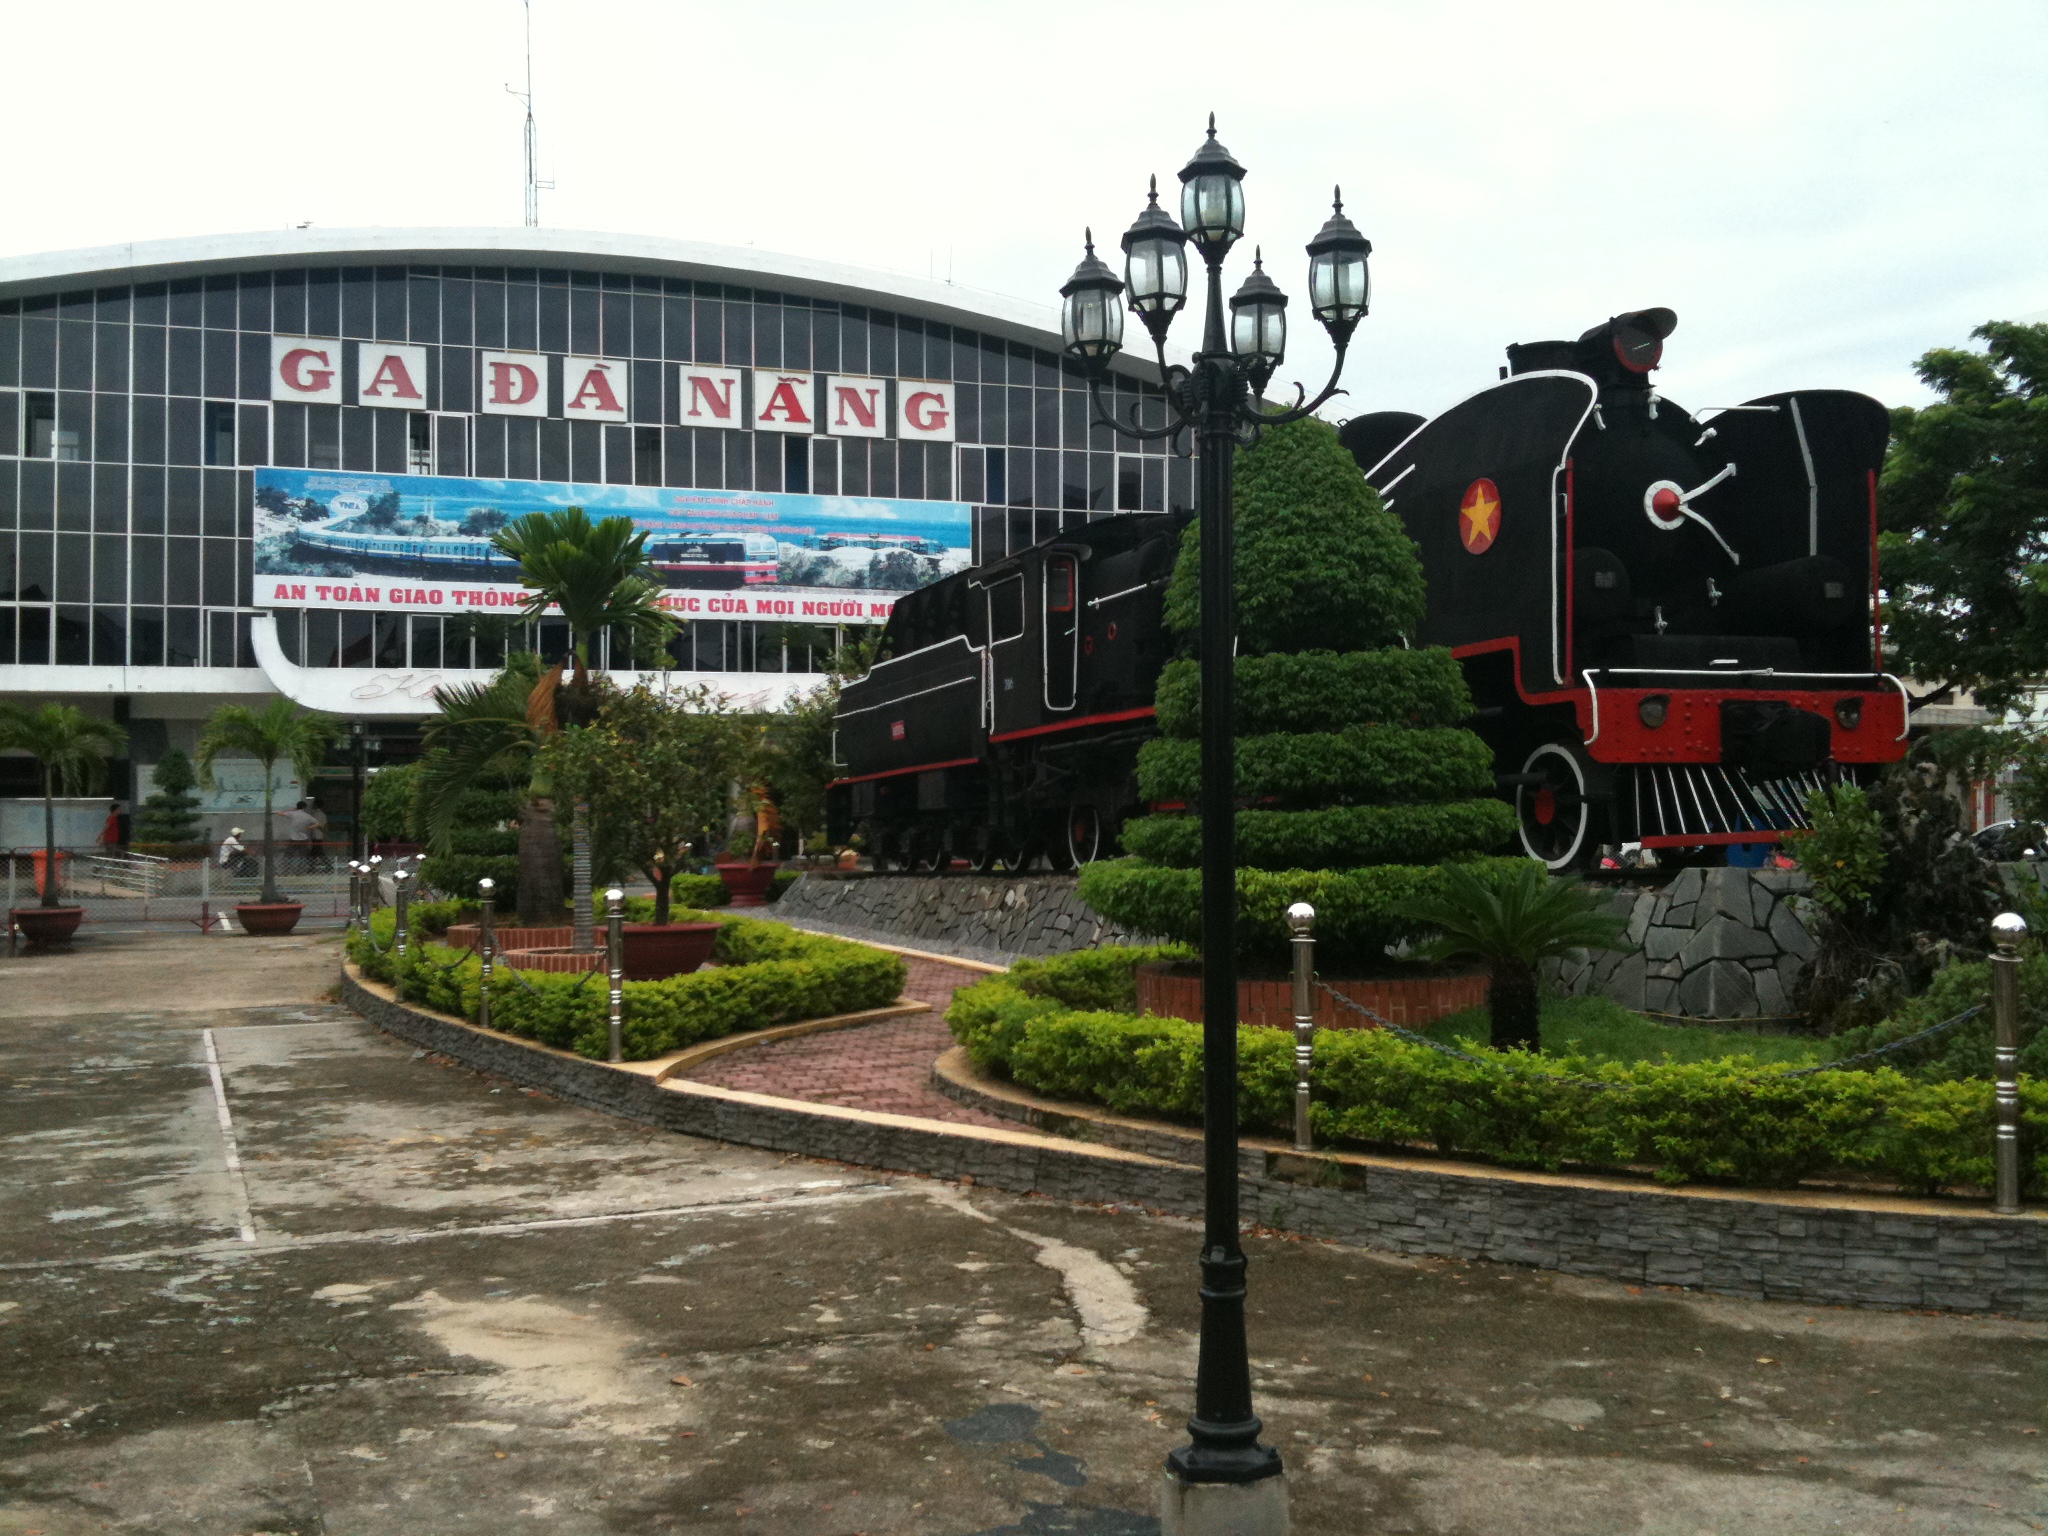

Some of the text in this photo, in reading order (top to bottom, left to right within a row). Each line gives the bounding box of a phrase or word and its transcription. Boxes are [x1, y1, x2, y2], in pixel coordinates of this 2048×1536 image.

[279, 348, 423, 399] GA
[489, 361, 625, 412] ĐÀ
[274, 584, 306, 600] AN
[315, 582, 380, 603] TOÀN
[389, 588, 443, 605] GIAO
[708, 592, 749, 613] CỦA
[756, 599, 794, 618] MỌI
